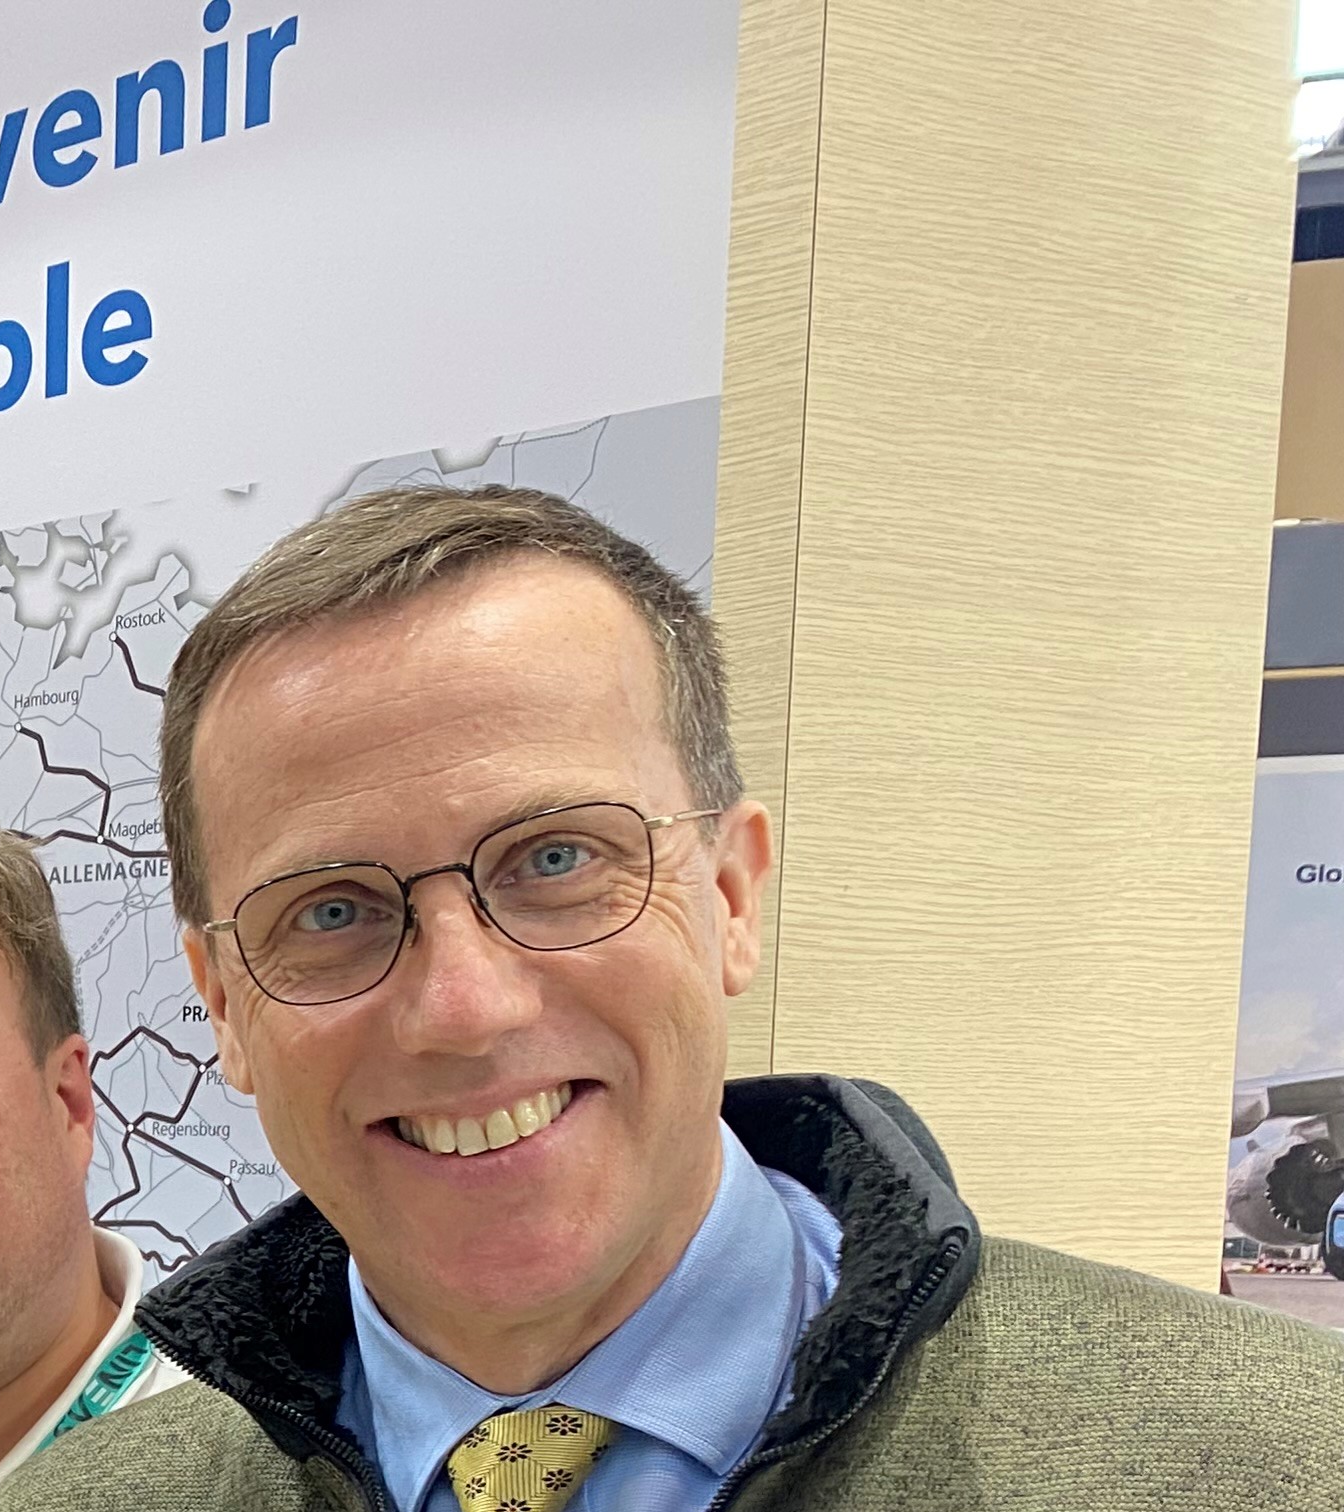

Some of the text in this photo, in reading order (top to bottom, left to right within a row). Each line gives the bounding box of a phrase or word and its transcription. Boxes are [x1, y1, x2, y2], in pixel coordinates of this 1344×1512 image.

[114, 609, 166, 630] Rostock
[14, 689, 80, 709] Hambourg
[108, 819, 162, 840] Magdeb
[50, 859, 170, 885] ALLEMAGNE
[152, 1121, 231, 1140] Regensburg
[229, 1159, 275, 1175] Passau
